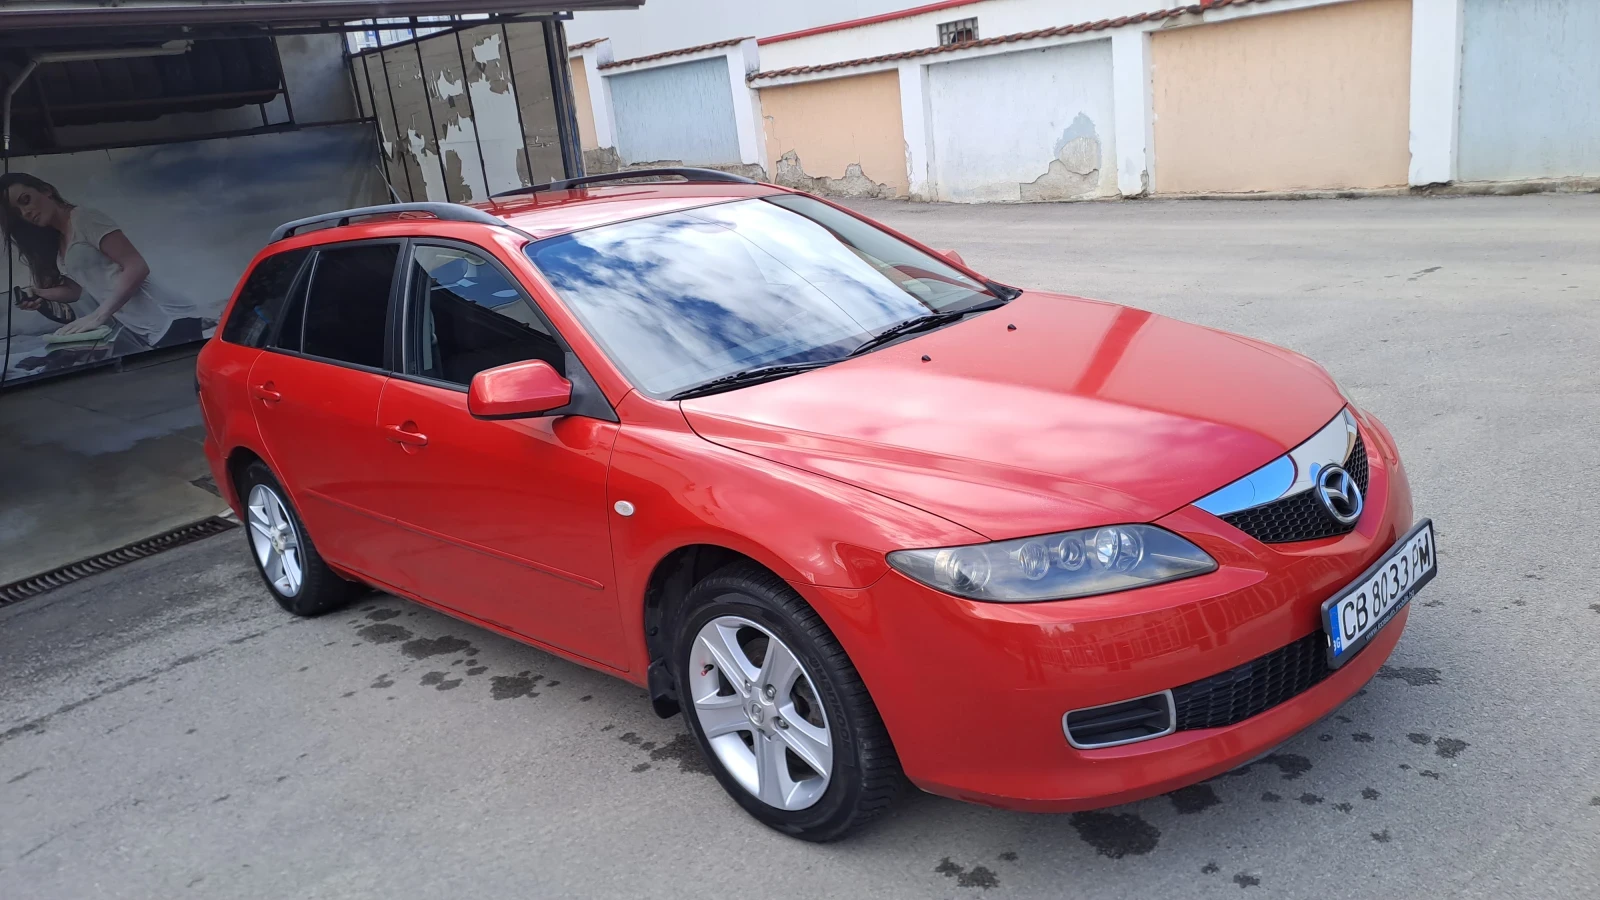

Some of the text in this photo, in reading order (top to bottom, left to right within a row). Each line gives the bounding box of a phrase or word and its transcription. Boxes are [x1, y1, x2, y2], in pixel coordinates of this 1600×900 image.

[1342, 532, 1431, 641] CB 8033 PM
